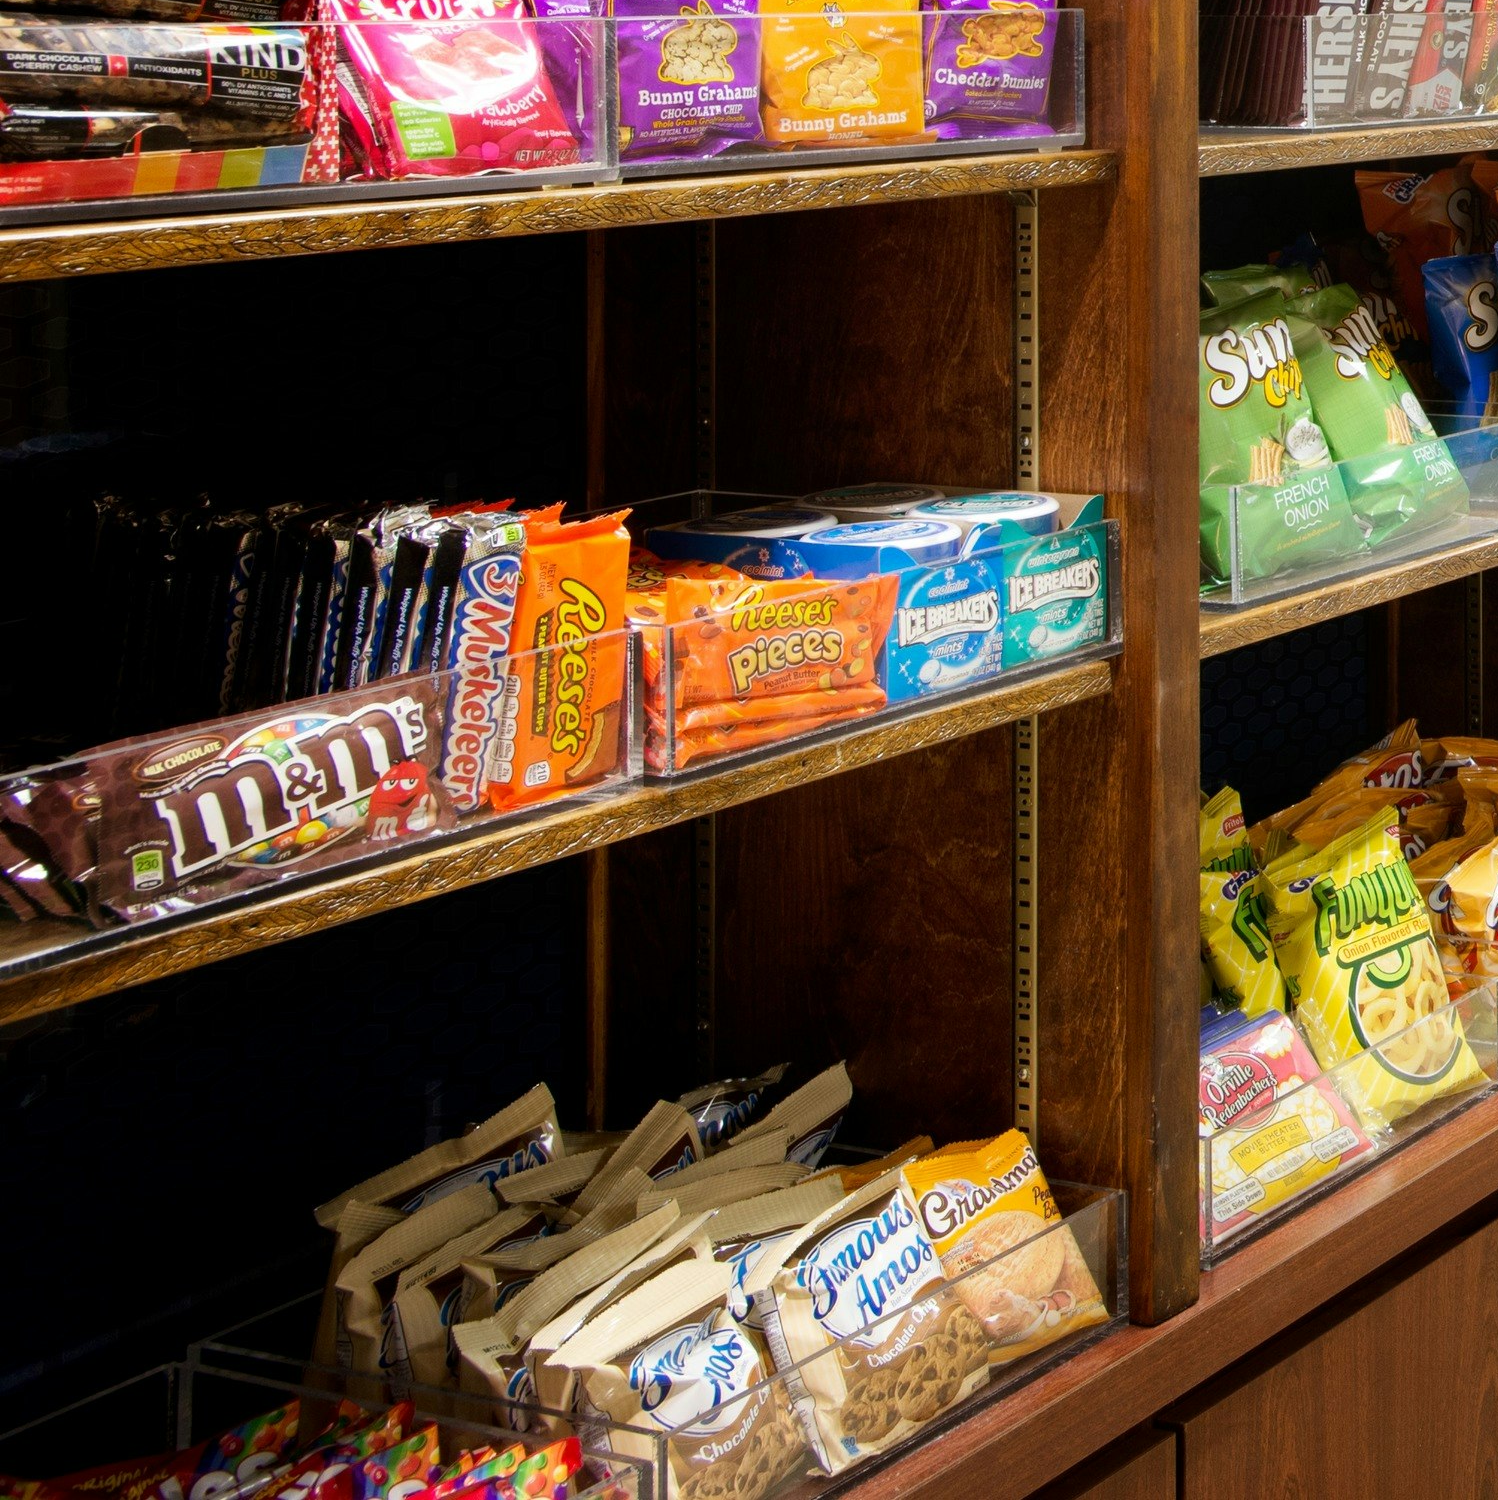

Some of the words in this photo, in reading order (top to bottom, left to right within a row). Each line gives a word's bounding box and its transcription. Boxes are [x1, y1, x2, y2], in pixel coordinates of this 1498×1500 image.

[38, 53, 103, 65] CHOCOLATE
[55, 62, 103, 74] CASHEW
[133, 62, 203, 78] ANTIOXIDANTS
[240, 67, 278, 81] PLUS
[934, 67, 1000, 88] Cheddar
[1002, 73, 1047, 91] Bunnies
[638, 89, 694, 107] Bunny
[698, 84, 759, 102] Grahams
[779, 116, 835, 134] Bunny
[839, 111, 908, 129] Grahams
[1205, 317, 1294, 409] Sun
[1273, 474, 1330, 510] FRENCH
[1284, 495, 1330, 528] ONION
[1027, 546, 1080, 568] wintergreen
[486, 563, 517, 600] 3
[928, 579, 970, 596] coolmint
[1034, 558, 1100, 597] BREAKERS
[711, 586, 838, 632] Reese's
[897, 606, 926, 647] ICE
[926, 590, 999, 631] BREAKERS
[1040, 607, 1068, 623] mints
[933, 640, 964, 658] mints
[552, 577, 607, 755] Reese's
[763, 674, 791, 690] Peanut
[792, 669, 821, 683] Butter
[535, 710, 545, 734] CUPS
[165, 741, 222, 769] CHOCOLATE
[136, 857, 160, 871] 230
[1342, 941, 1371, 959] Onion
[1371, 926, 1411, 950] Flavored
[1206, 1062, 1255, 1105] Orville
[1202, 1073, 1278, 1129] Redenbacher's
[1238, 1139, 1263, 1160] MOVIE
[1262, 1121, 1301, 1144] THEATER
[1258, 1136, 1286, 1155] BUTTER
[797, 1200, 915, 1322] Famous
[854, 1230, 933, 1329] Amos
[867, 1322, 916, 1368] Chocolate
[699, 1405, 760, 1464] Chocolate
